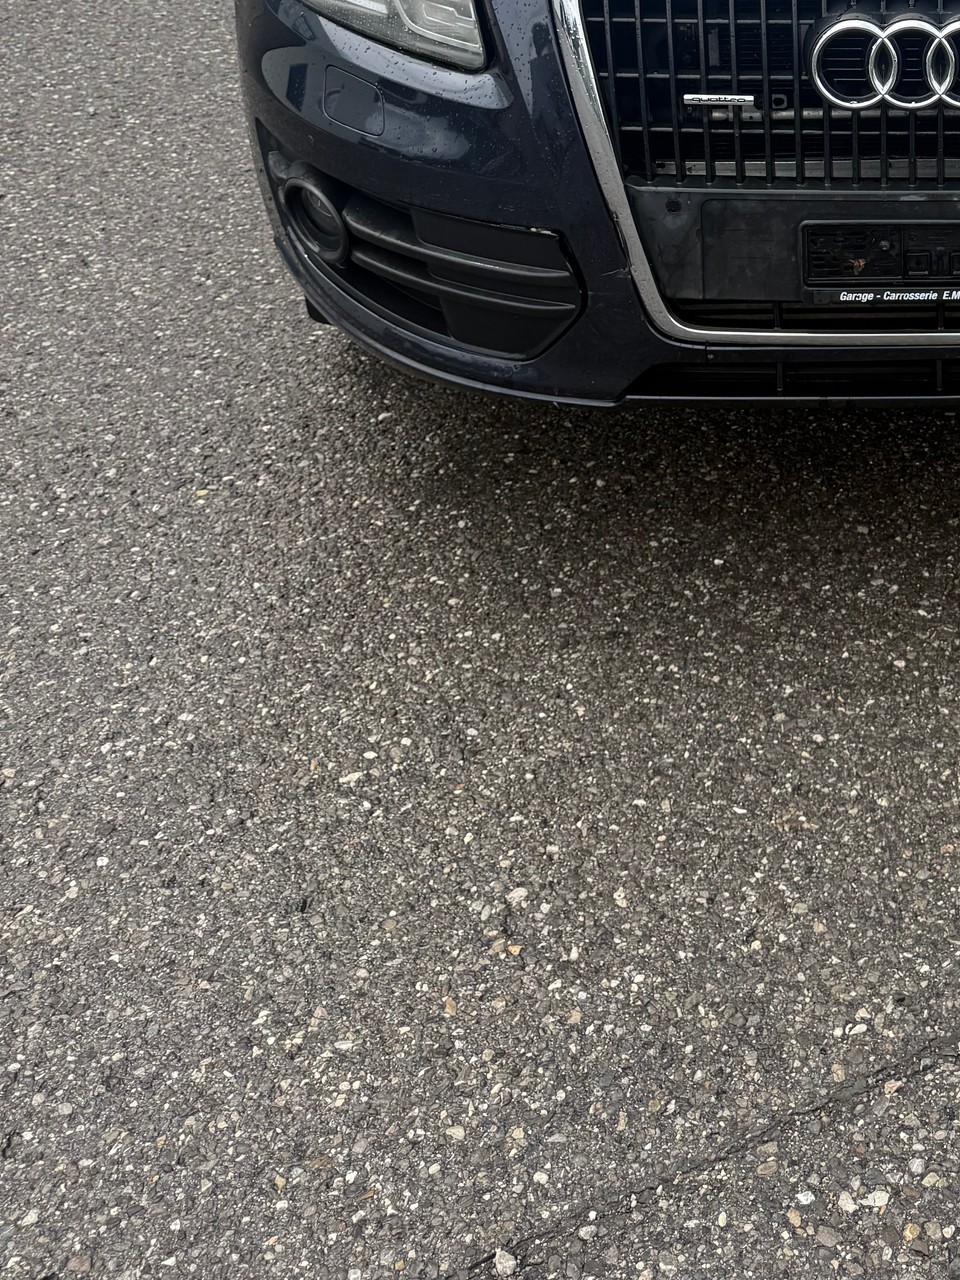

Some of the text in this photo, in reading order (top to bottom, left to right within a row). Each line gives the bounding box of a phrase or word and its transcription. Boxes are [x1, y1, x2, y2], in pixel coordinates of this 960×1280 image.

[691, 96, 746, 104] quattro
[840, 291, 875, 303] Garage
[883, 290, 938, 301] Carrosserie
